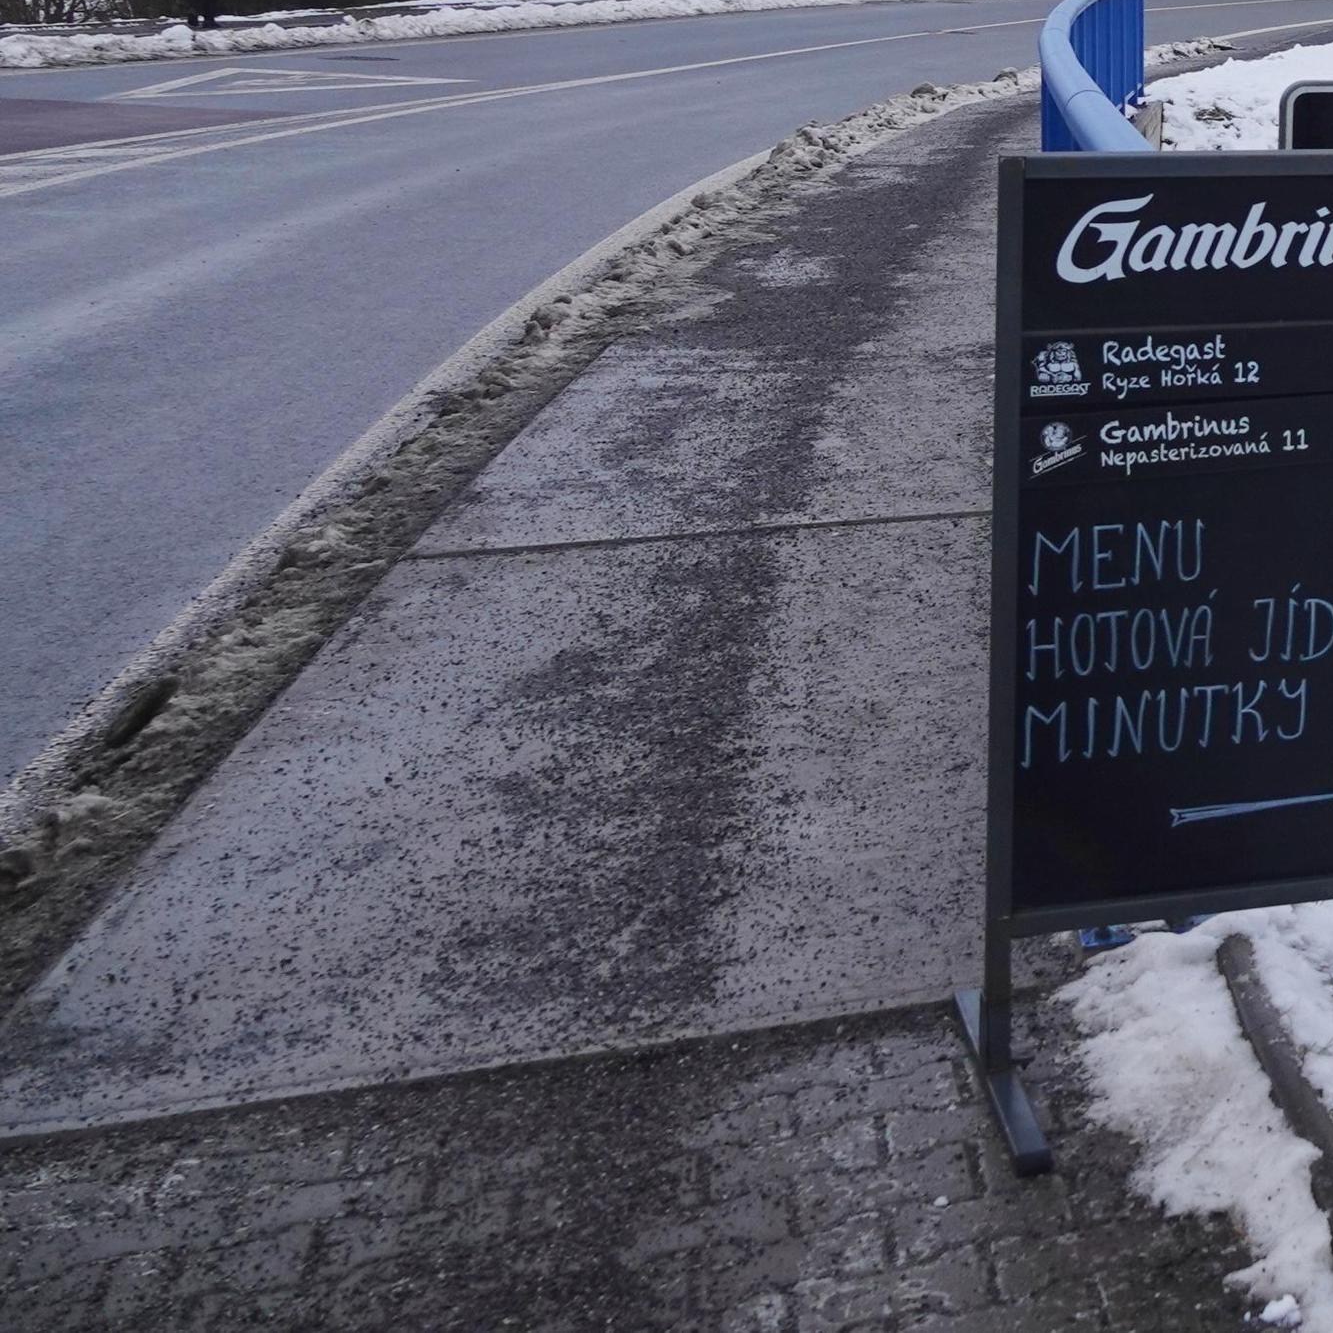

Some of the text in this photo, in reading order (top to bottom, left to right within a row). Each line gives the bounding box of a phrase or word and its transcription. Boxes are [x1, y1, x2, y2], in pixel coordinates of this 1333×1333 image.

[1102, 334, 1226, 370] Radegast
[1030, 382, 1091, 396] RADEGAST
[1102, 361, 1260, 399] Ryze Hořká 12
[1100, 411, 1250, 444] Gambrinus
[1033, 443, 1083, 474] Gambrinus
[1100, 428, 1309, 476] Nepasterizovaná 11
[1028, 518, 1206, 596] MENU
[1026, 587, 1218, 681] HOTOVÁ
[1020, 677, 1307, 768] MINUTKY
